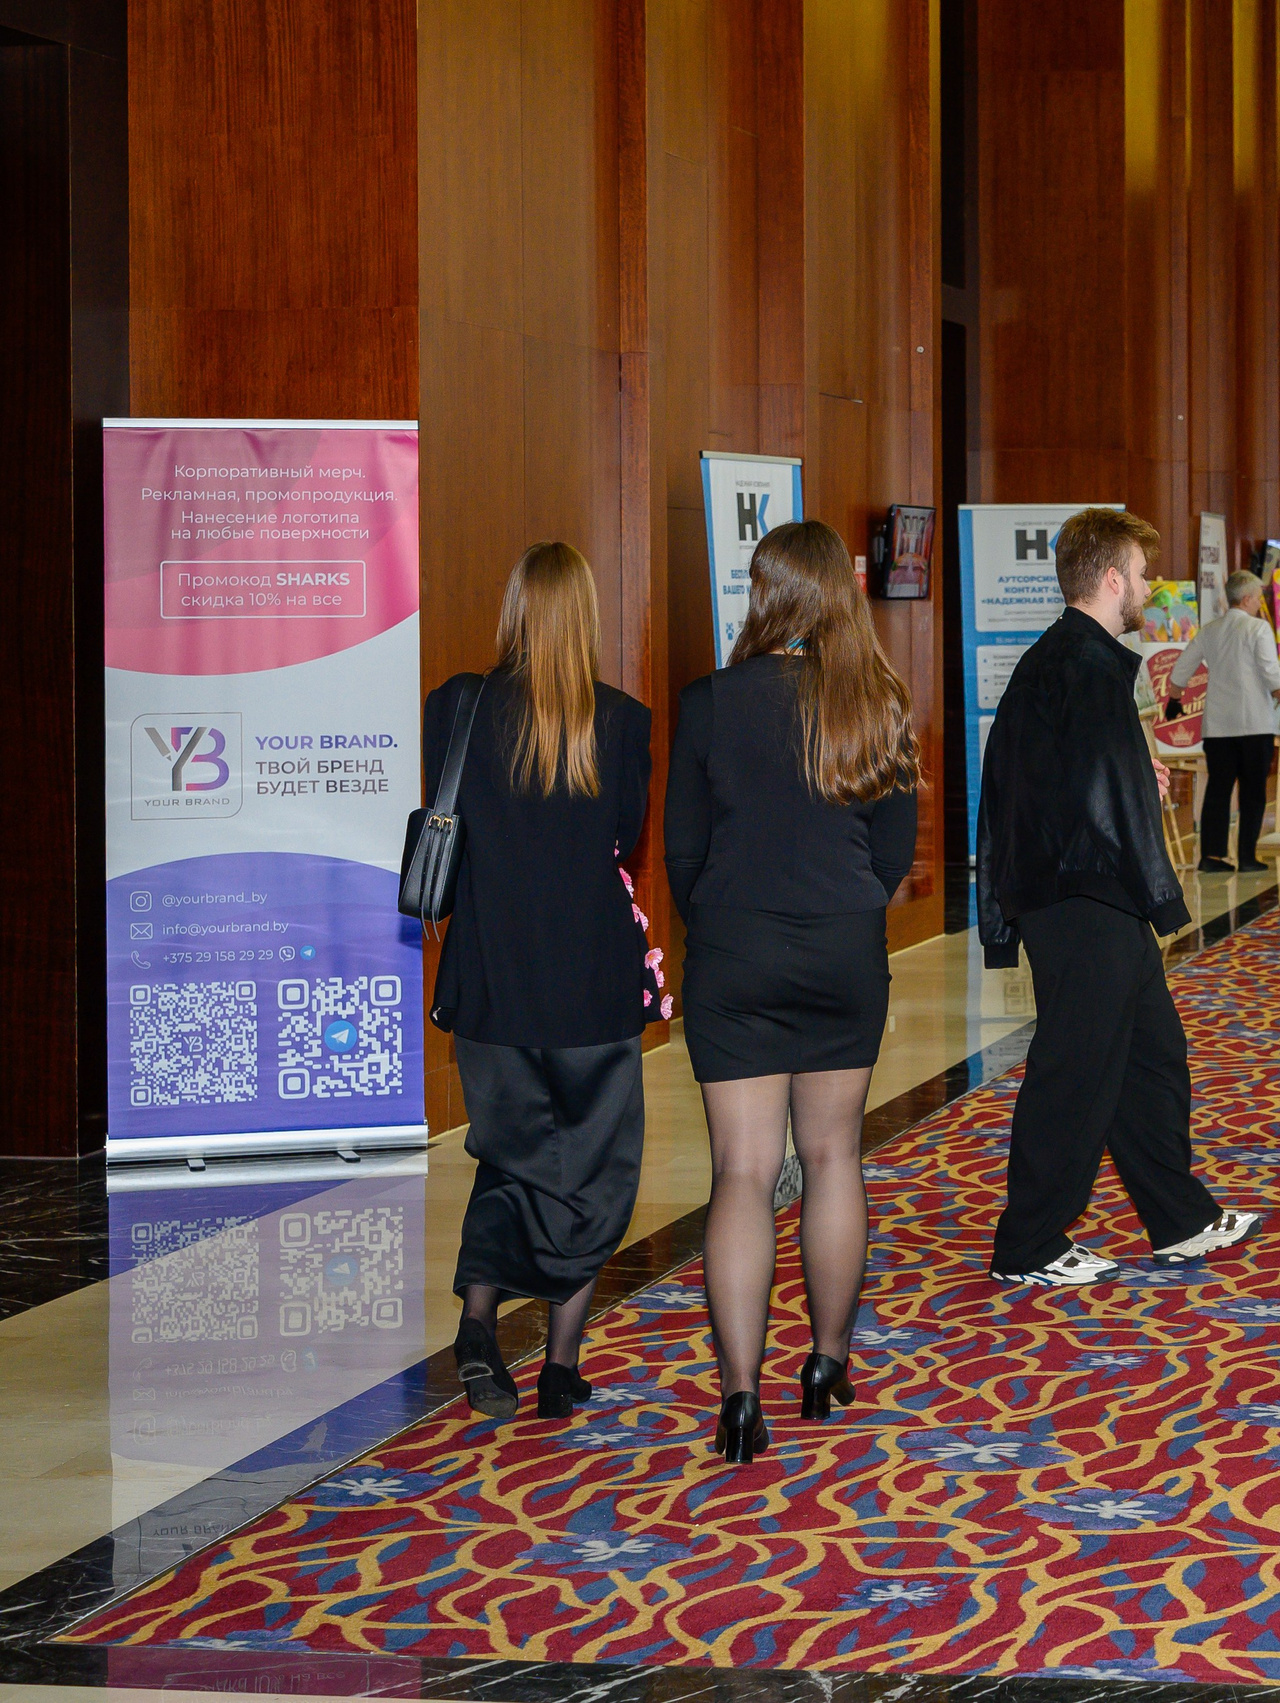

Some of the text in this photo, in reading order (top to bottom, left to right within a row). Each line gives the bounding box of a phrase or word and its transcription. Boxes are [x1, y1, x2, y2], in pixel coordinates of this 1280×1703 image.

[174, 464, 366, 481] Корпоративный мерч.
[141, 488, 398, 504] Рекламная, промопродукция.
[181, 511, 360, 526] Нанесение логотипа
[171, 527, 369, 542] на любые поверхности
[178, 572, 350, 588] Промокод SHARKS
[998, 575, 1058, 583] АУТСОРСИН
[181, 592, 342, 608] скидка 10% на все
[255, 734, 398, 750] YOUR BRAND.
[256, 757, 384, 776] ТВОЙ БРЕНД
[256, 778, 389, 797] БУДЕТ ВЕЗДЕ
[144, 797, 230, 807] YOUR BRAND
[162, 892, 267, 908] @yourbrand_by
[162, 921, 289, 937] info@yourbrand.by
[163, 949, 274, 964] +375 29 158 29 29
